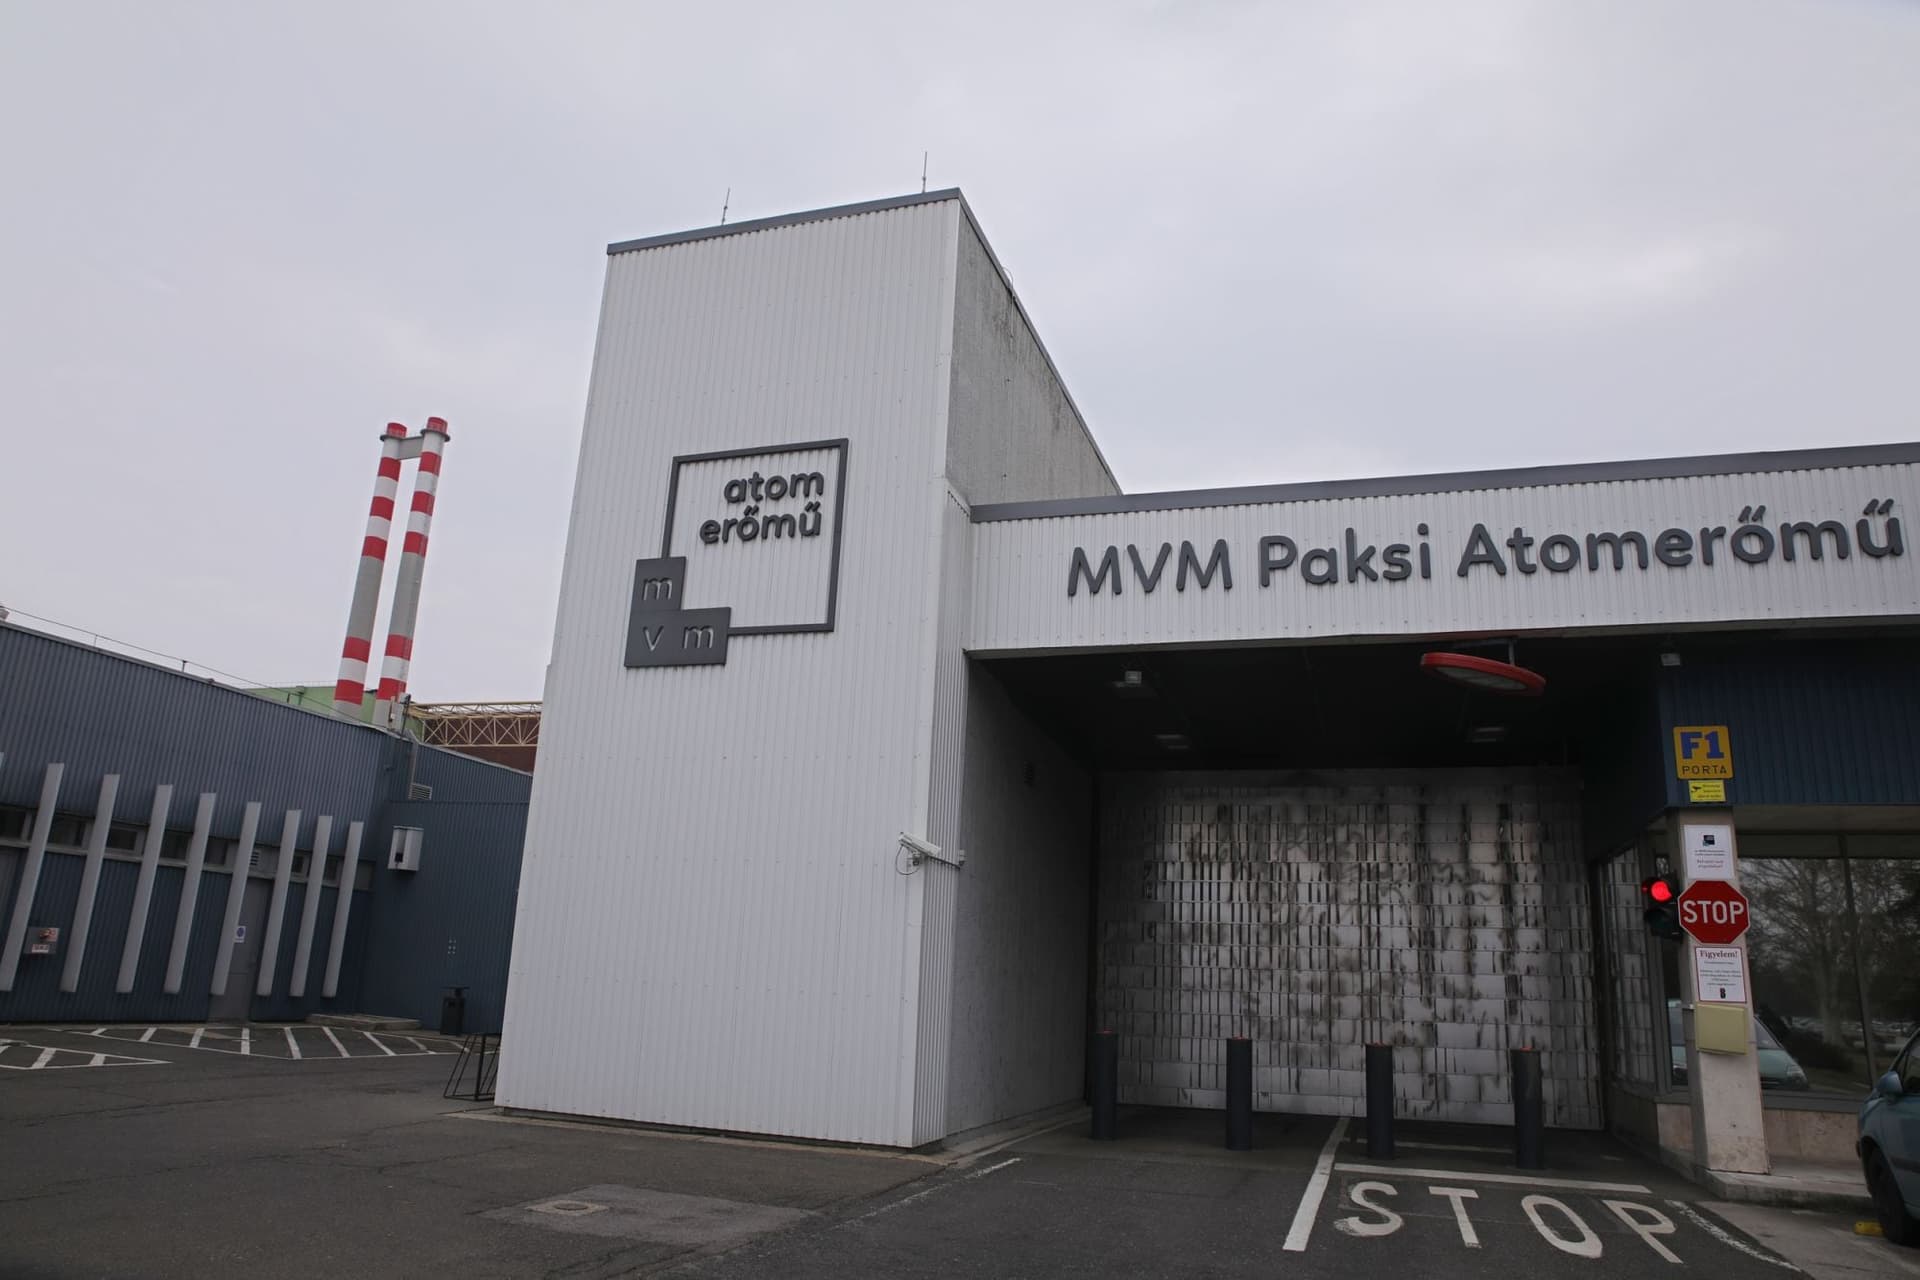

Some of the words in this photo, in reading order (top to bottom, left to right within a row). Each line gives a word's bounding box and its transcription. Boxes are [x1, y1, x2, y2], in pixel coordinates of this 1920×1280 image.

[724, 471, 824, 504] atom
[699, 501, 822, 545] erőmű
[1068, 538, 1233, 596] MVM
[1259, 523, 1431, 588] Paksi
[1457, 498, 1905, 577] Atomerőmű
[1680, 730, 1725, 760] F1
[1682, 765, 1727, 775] PORTA
[1682, 900, 1744, 925] STOP
[1700, 950, 1738, 960] Figyelem!
[1333, 1181, 1684, 1265] STOP
